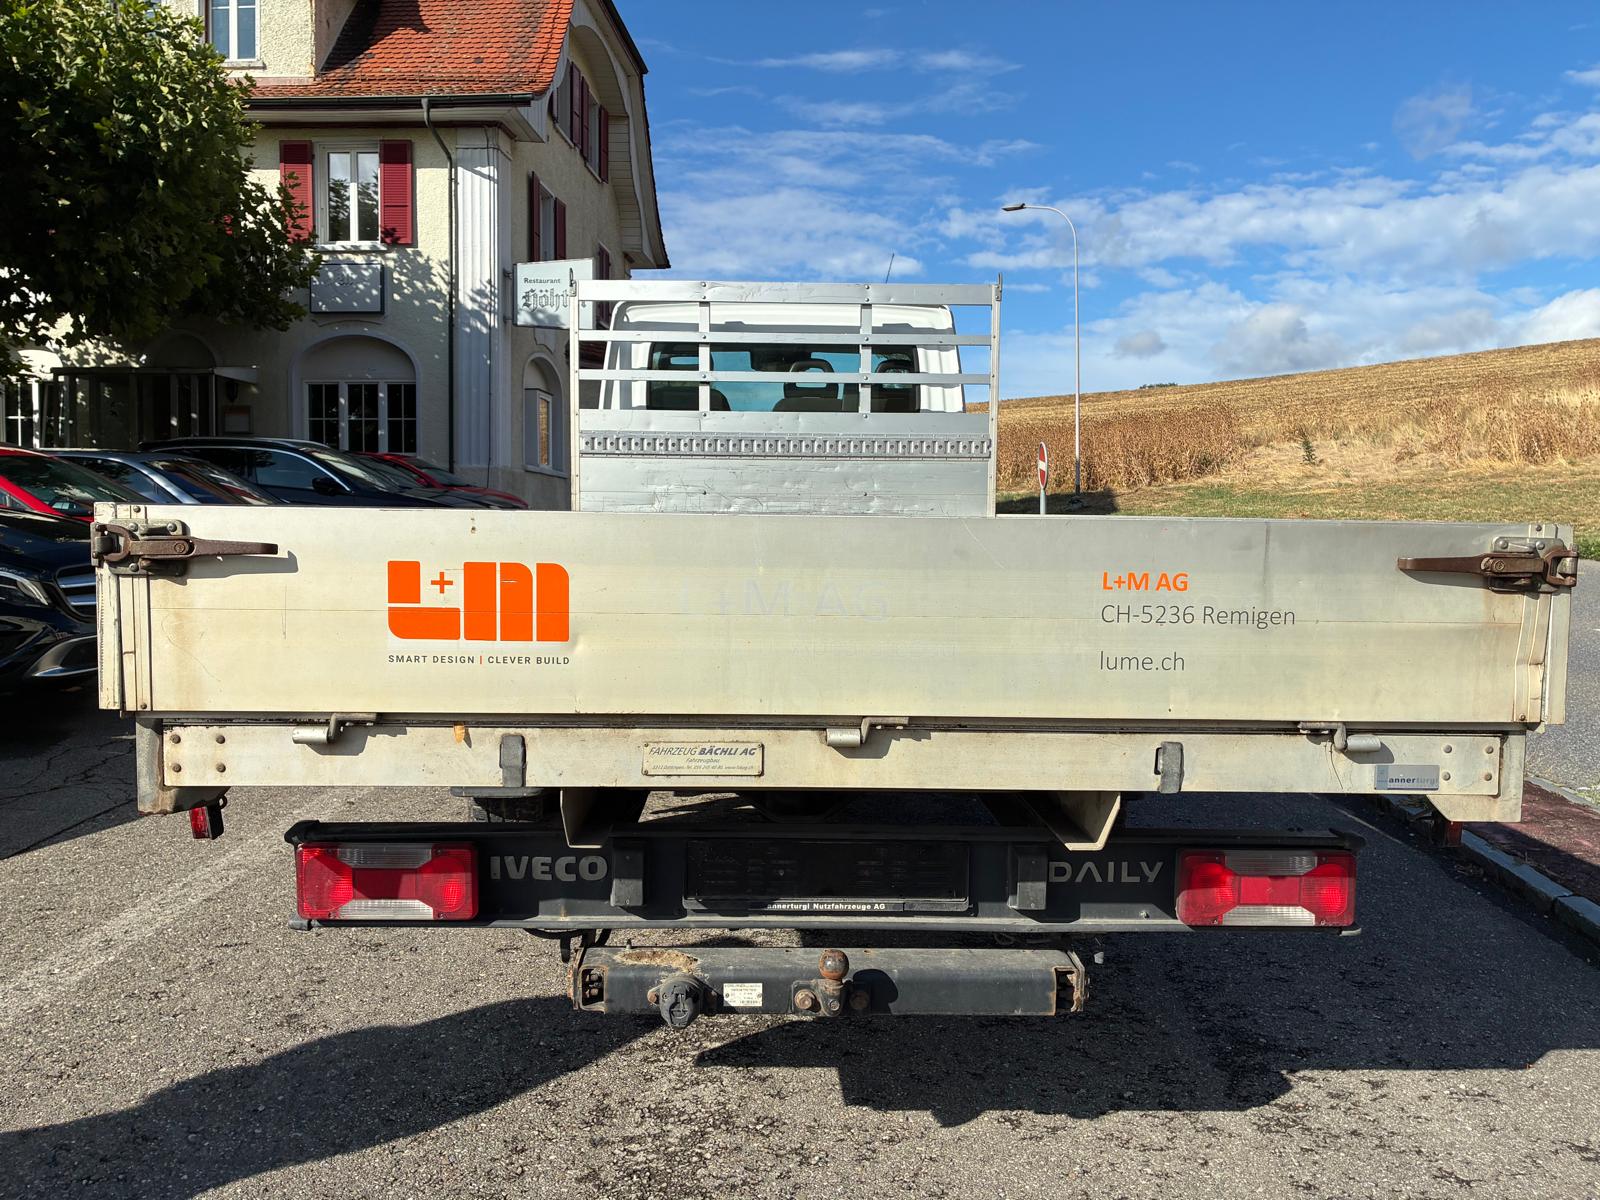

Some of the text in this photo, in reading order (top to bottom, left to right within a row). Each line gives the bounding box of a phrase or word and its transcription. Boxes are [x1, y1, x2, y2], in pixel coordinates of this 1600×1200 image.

[1102, 571, 1189, 591] L+M AG
[1101, 604, 1295, 630] CH-5236 Remigen
[388, 655, 570, 665] SMART DESIGN CLEVER BUILD
[1100, 650, 1185, 671] lume.ch
[649, 745, 757, 756] FAHRZEUG BÄCHLI AG
[489, 855, 609, 882] IVECO
[1050, 861, 1165, 884] DAILY
[813, 903, 872, 911] Nutzfahrzeuge
